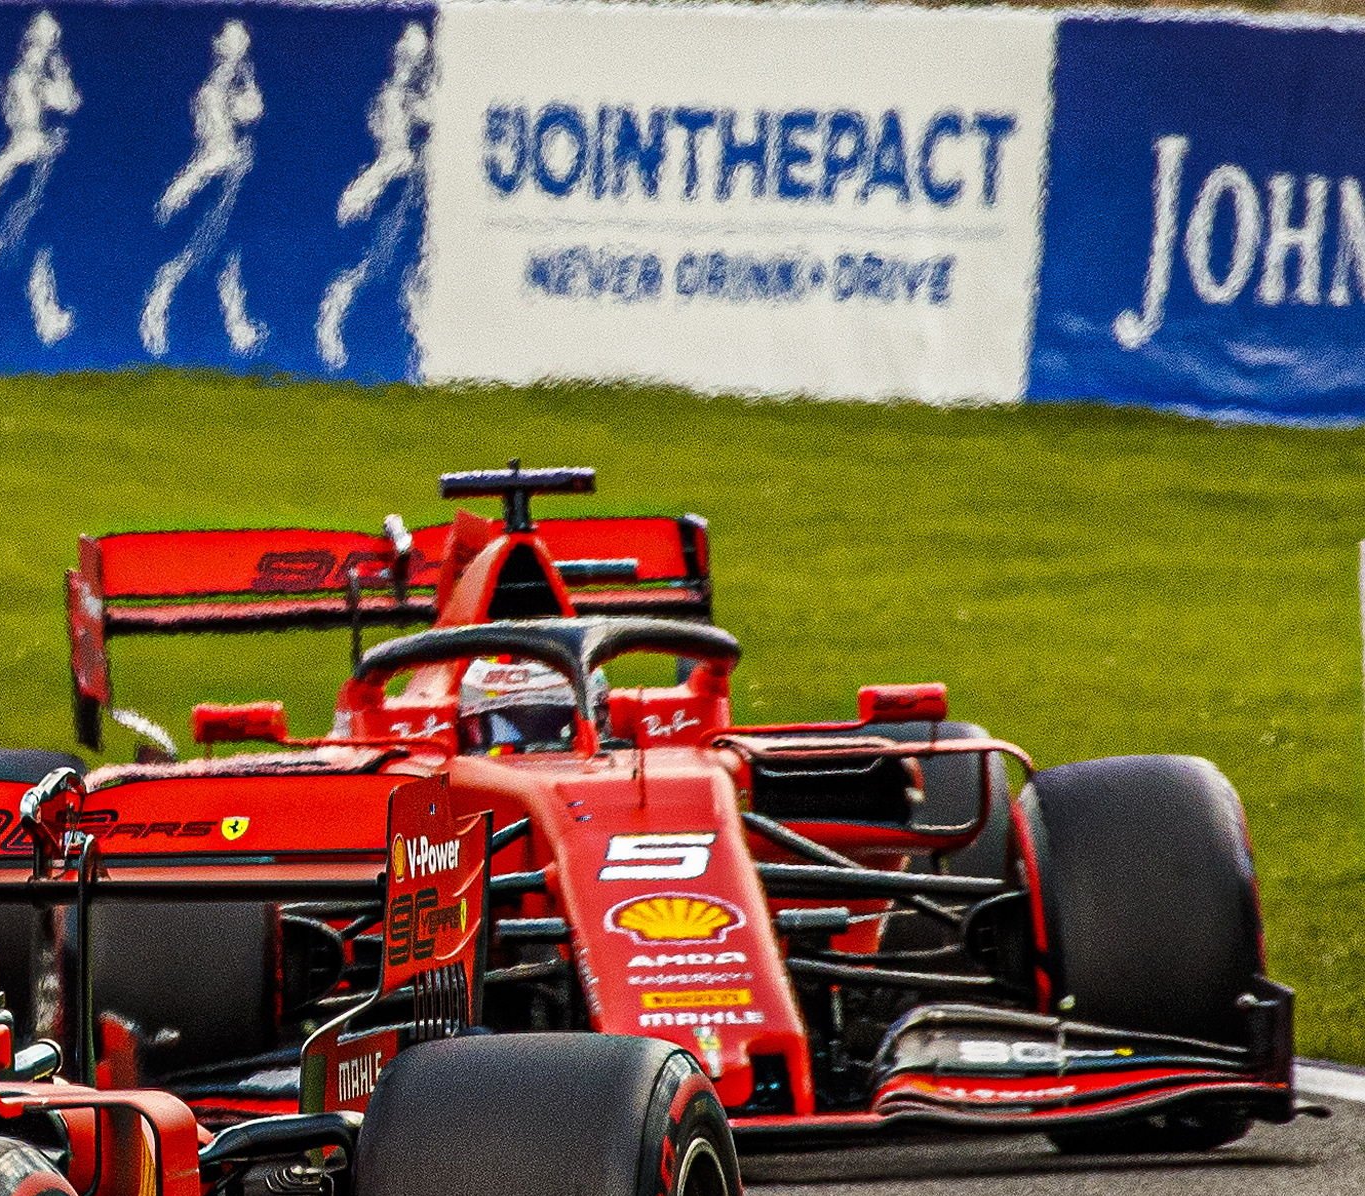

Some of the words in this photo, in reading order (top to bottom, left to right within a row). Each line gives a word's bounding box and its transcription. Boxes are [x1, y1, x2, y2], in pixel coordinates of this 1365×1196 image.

[406, 836, 460, 879] V-Power
[598, 832, 718, 881] 5
[638, 1011, 765, 1027] MAHLE
